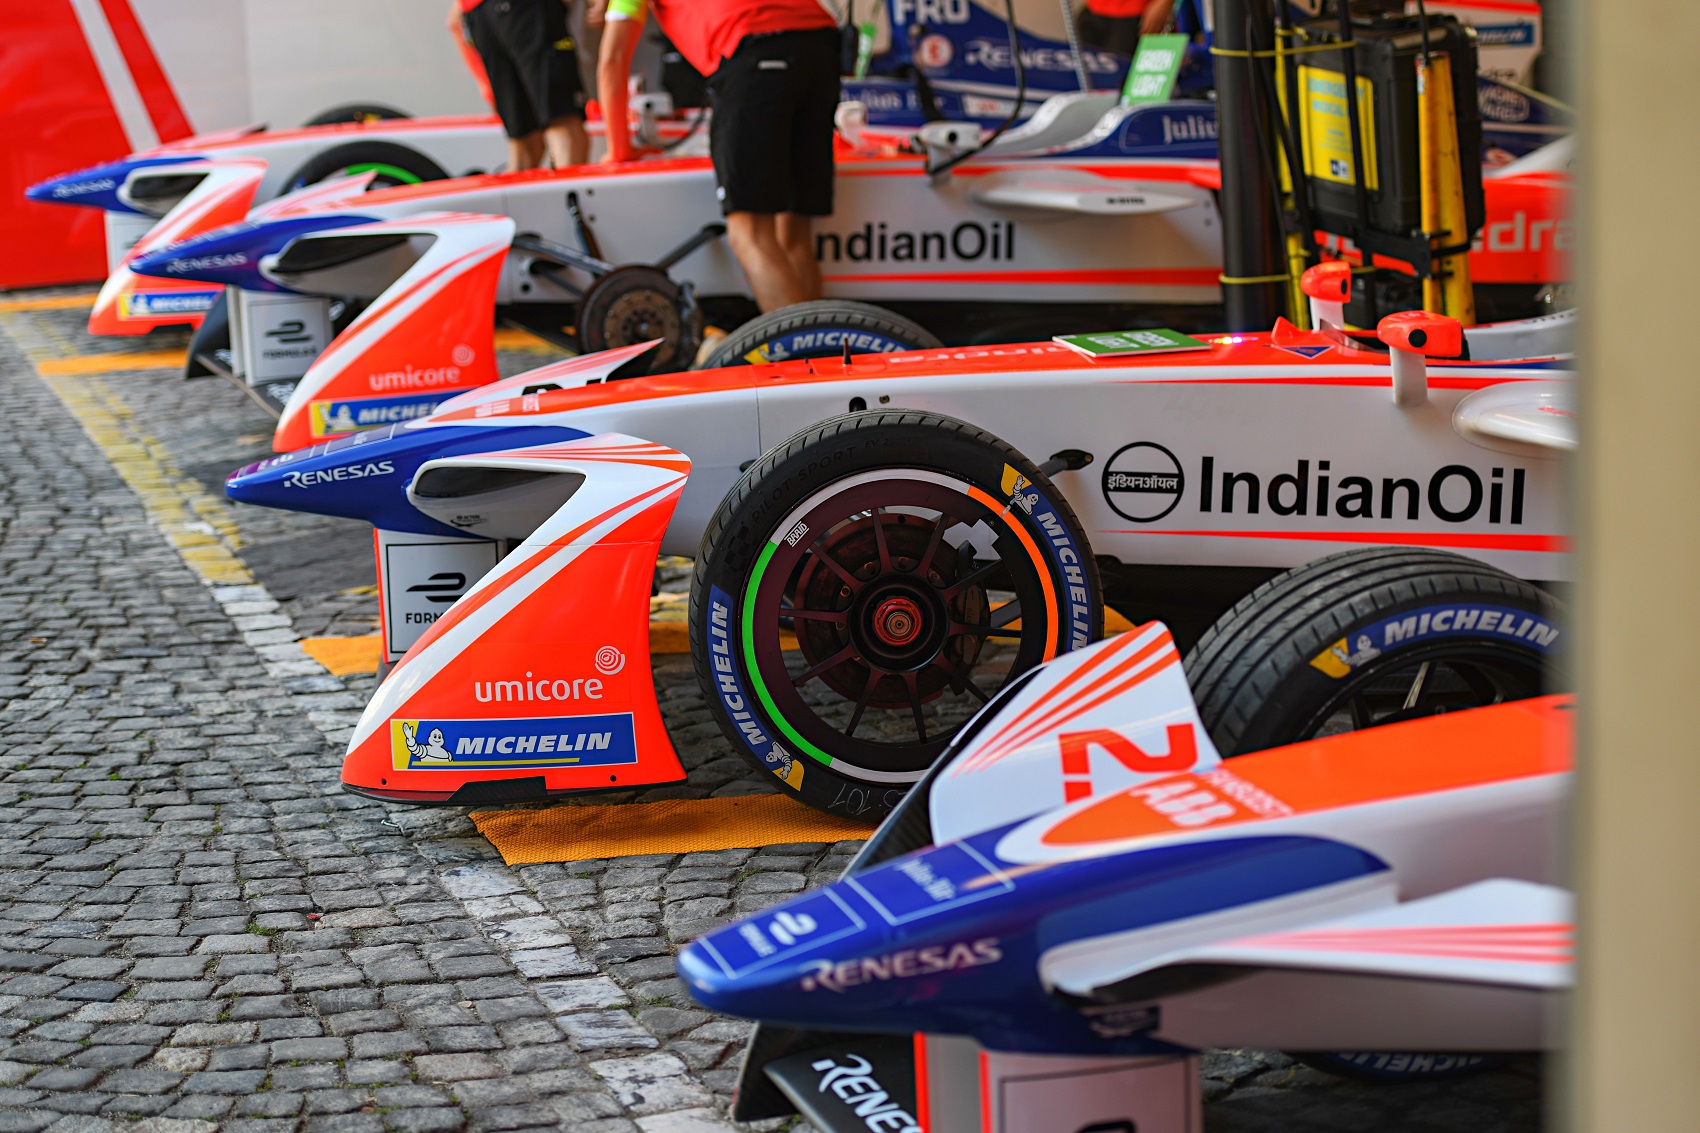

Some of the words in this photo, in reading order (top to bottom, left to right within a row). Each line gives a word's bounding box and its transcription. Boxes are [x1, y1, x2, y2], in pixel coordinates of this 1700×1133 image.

[1162, 114, 1218, 145] Juliu
[815, 221, 1016, 263] ndianOil
[166, 252, 248, 274] RENESAS
[369, 364, 461, 391] umicore
[357, 402, 437, 424] MICHE
[282, 460, 395, 488] RENESAS
[1199, 455, 1526, 525] IndianOil
[786, 522, 807, 547] BRAID
[1384, 609, 1560, 648] MICHELIN
[474, 671, 604, 703] umicore
[711, 601, 768, 746] MICHELIN
[455, 732, 613, 755] MICHELIN
[799, 938, 1003, 993] RENESAS
[811, 1053, 924, 1133] RENE
